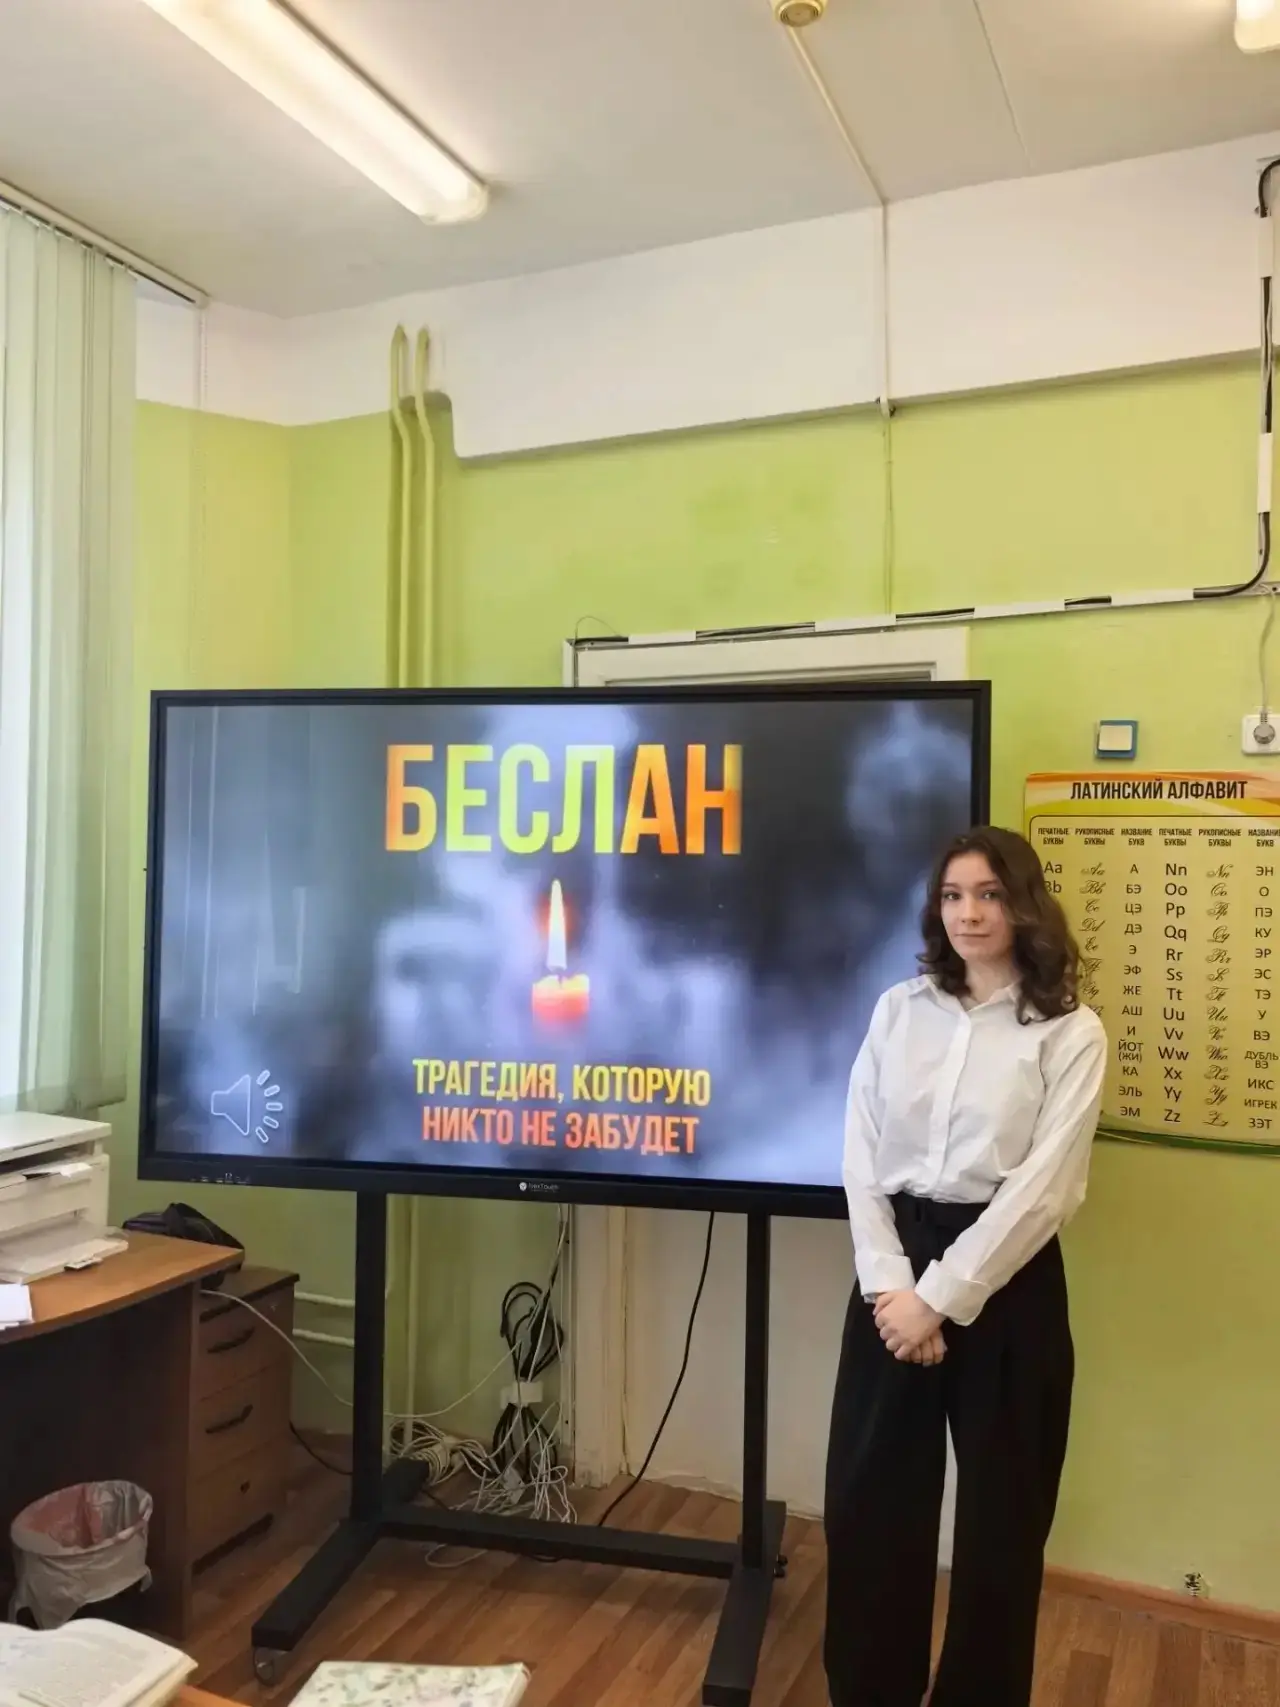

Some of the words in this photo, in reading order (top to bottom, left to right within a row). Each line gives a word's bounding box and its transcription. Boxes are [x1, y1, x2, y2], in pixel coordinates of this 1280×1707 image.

[1070, 779, 1163, 799] ЛАТИНСКИЙ
[1167, 781, 1248, 799] АЛФАВИТ
[385, 743, 744, 856] БЕСЛАН
[1038, 828, 1069, 836] ПЕЧАТНЫЕ
[1075, 828, 1115, 836] РУКОПИСНЫЕ
[1121, 828, 1152, 836] НАЗВАНИЕ
[1159, 828, 1192, 836] ПЕЧАТНЫЕ
[1199, 829, 1241, 837] РУКОПИСНЫЕ
[1043, 837, 1064, 845] БУКВЫ
[1084, 838, 1105, 846] БУКВЫ
[1128, 838, 1144, 846] БУКВ
[1164, 838, 1186, 846] БУКВЫ
[1209, 839, 1231, 847] БУКВЫ
[1256, 839, 1274, 847] БУКВ
[1044, 861, 1063, 874] Aa
[1165, 864, 1187, 876] Nn
[1256, 867, 1274, 876] ЭН
[1126, 884, 1141, 894] БЭ
[1165, 883, 1188, 896] Oo
[1125, 903, 1141, 914] ЦЭ
[1166, 902, 1185, 918] Pp
[1255, 908, 1273, 917] ПЭ
[1124, 924, 1142, 934] ДЭ
[1164, 925, 1187, 941] Qq
[1255, 928, 1271, 938] КУ
[1129, 945, 1137, 954] Э
[1166, 949, 1183, 961] Rr
[1255, 949, 1271, 959] ЭР
[1124, 966, 1141, 975] ЭФ
[1166, 968, 1183, 981] Ss
[1254, 969, 1271, 979] ЭС
[1123, 986, 1141, 995] ЖЕ
[1167, 988, 1183, 1001] Tt
[1256, 990, 1271, 1000] ТЭ
[1122, 1005, 1142, 1016] АШ
[1163, 1008, 1185, 1021] Uu
[1164, 1028, 1184, 1040] Vv
[1254, 1031, 1270, 1040] ВЭ
[1118, 1040, 1144, 1051] ЙОТ
[1118, 1052, 1142, 1062] (ЖИ)
[1158, 1047, 1189, 1061] Ww
[1244, 1051, 1279, 1061] ДУБЛЬ
[1255, 1060, 1269, 1069] ВЭ
[1123, 1067, 1138, 1076] КА
[1164, 1067, 1182, 1080] Xx
[412, 1059, 565, 1103] ТРАГЕДИЯ,
[573, 1064, 711, 1106] КОТОРУЮ
[1248, 1079, 1274, 1090] ИКС
[1119, 1087, 1142, 1097] ЭЛЬ
[1164, 1087, 1182, 1102] Yy
[1244, 1099, 1278, 1109] ИГРЕК
[1120, 1107, 1140, 1117] ЭМ
[1164, 1110, 1181, 1122] Zz
[1249, 1118, 1272, 1129] ЗЭТ
[423, 1106, 514, 1144] НИКТО
[522, 1110, 556, 1146] НЕ
[565, 1112, 699, 1156] ЗАБУДЕТ
